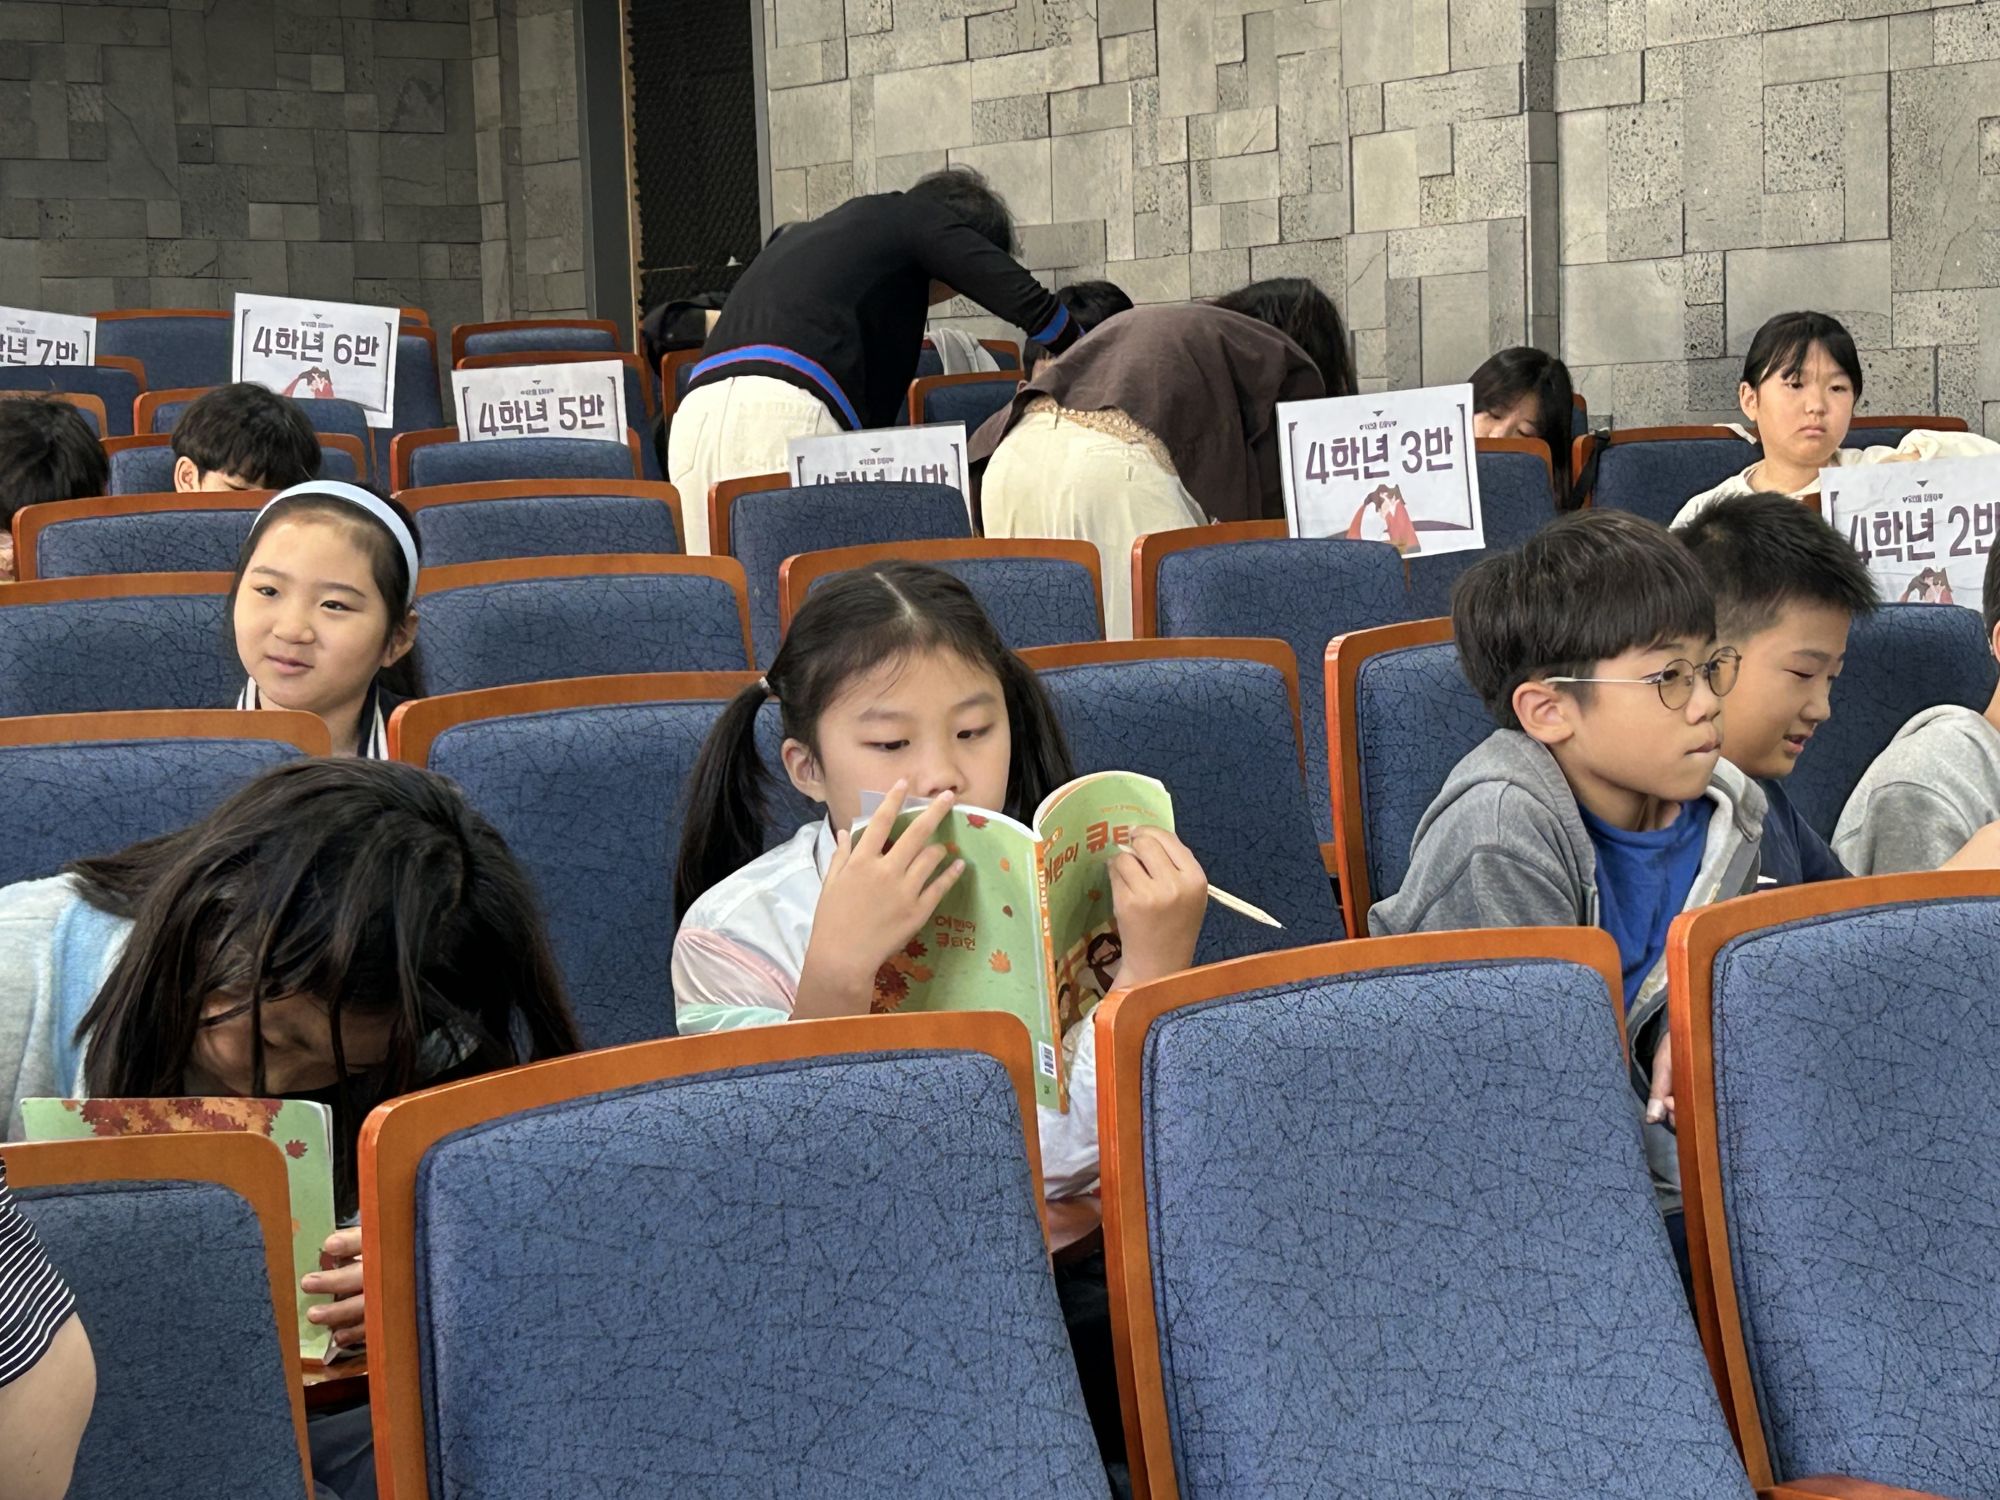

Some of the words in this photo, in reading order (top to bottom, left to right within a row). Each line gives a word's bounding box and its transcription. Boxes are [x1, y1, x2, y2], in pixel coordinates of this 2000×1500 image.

[252, 326, 324, 363] 4학년
[333, 333, 379, 367] 6반
[478, 398, 549, 437] 4학년
[558, 394, 605, 431] 5반
[1305, 433, 1390, 485] 4학년
[1400, 426, 1453, 474] 3반
[1850, 507, 1936, 566] 4학년
[1947, 501, 2000, 558] 2반
[934, 915, 976, 933] 어린이
